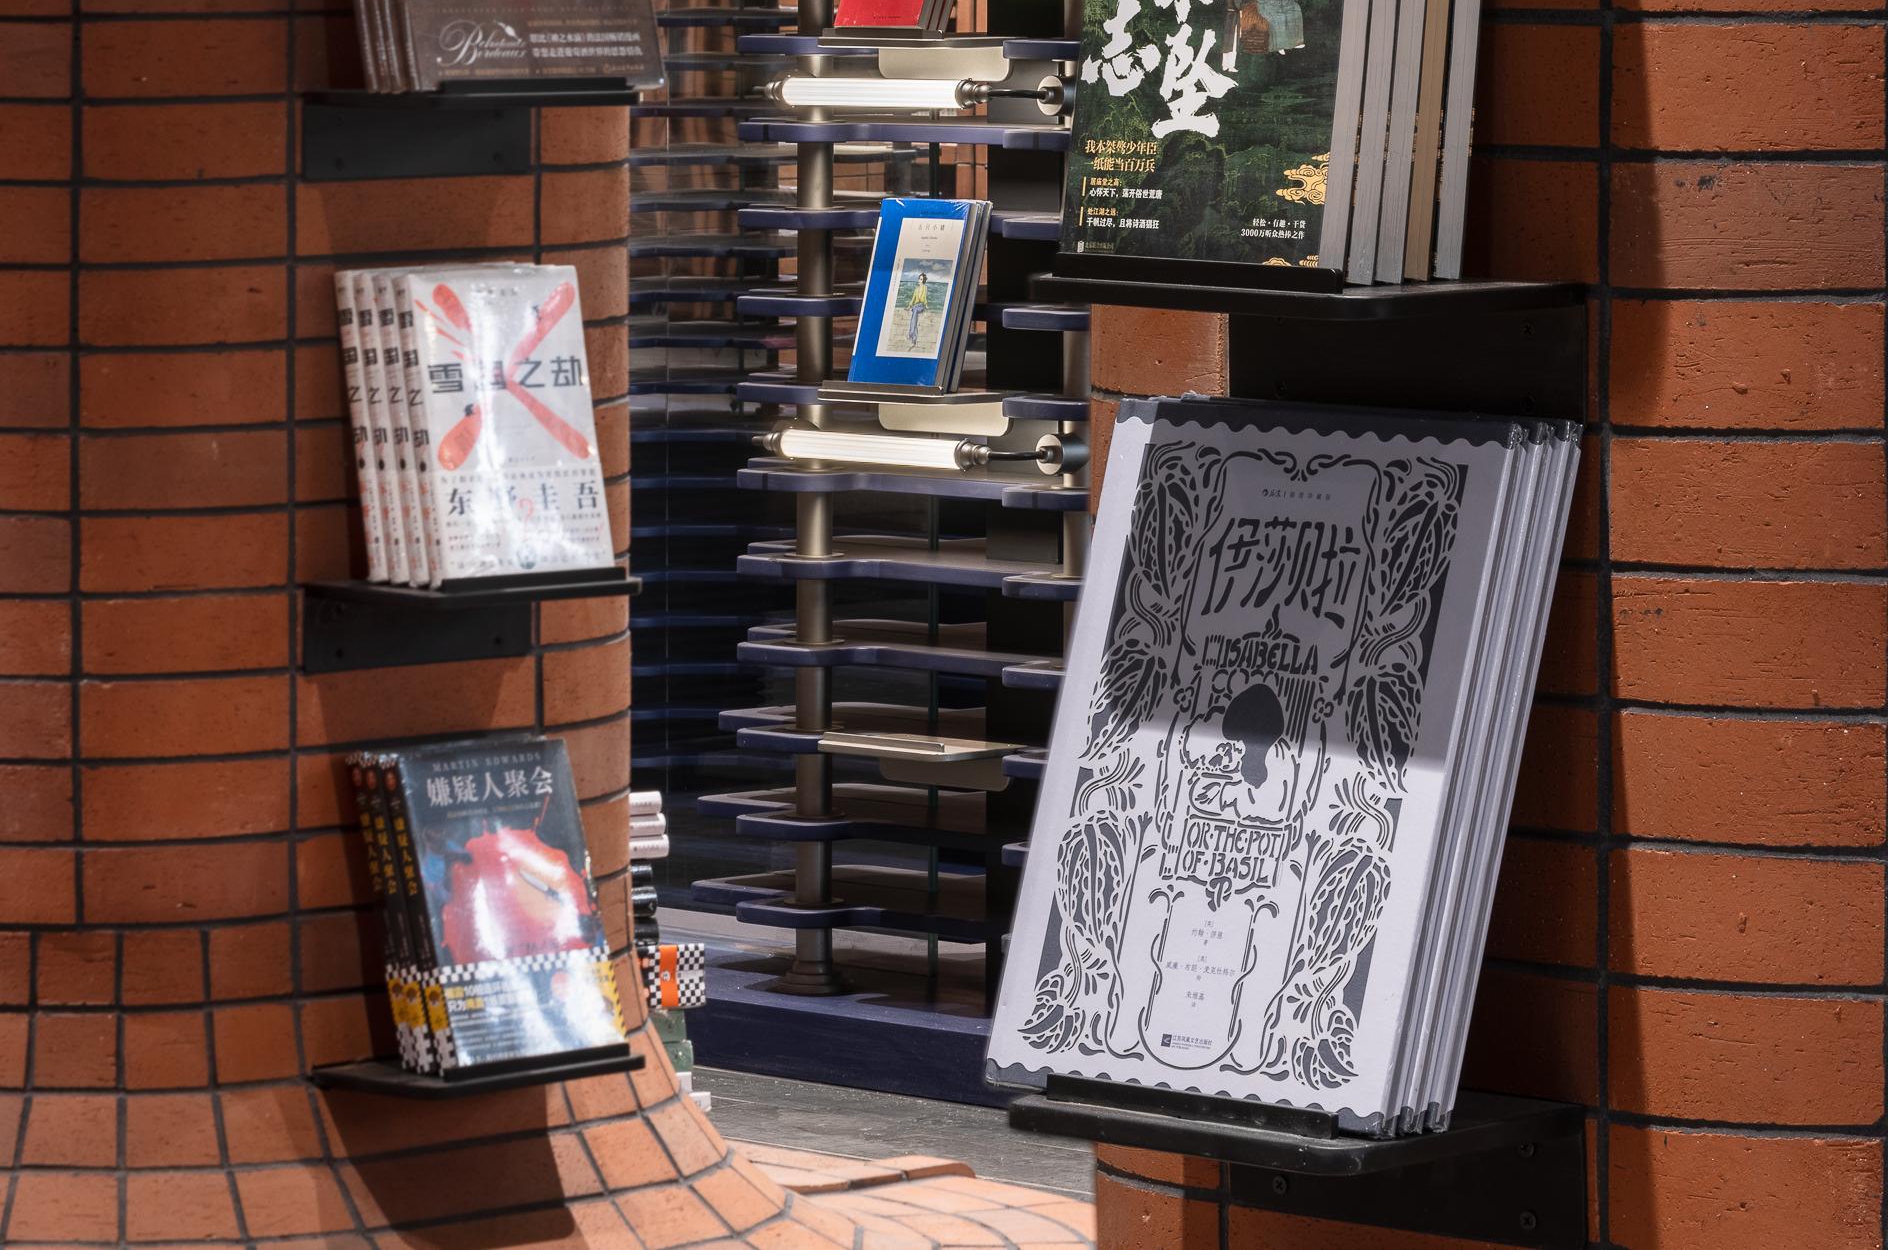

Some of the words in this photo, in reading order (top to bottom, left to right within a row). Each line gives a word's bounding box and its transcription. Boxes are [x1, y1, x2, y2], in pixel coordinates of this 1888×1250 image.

[1084, 139, 1157, 156] 我本桀骜少年臣
[1084, 157, 1156, 173] 一纸能当百万兵
[1240, 228, 1305, 240] 3000万听众热捧之作
[1201, 516, 1361, 629] 伊莎贝拉
[1219, 638, 1319, 676] ISABELLA
[432, 758, 479, 772] MARTIN
[426, 765, 554, 808] 嫌疑人聚会
